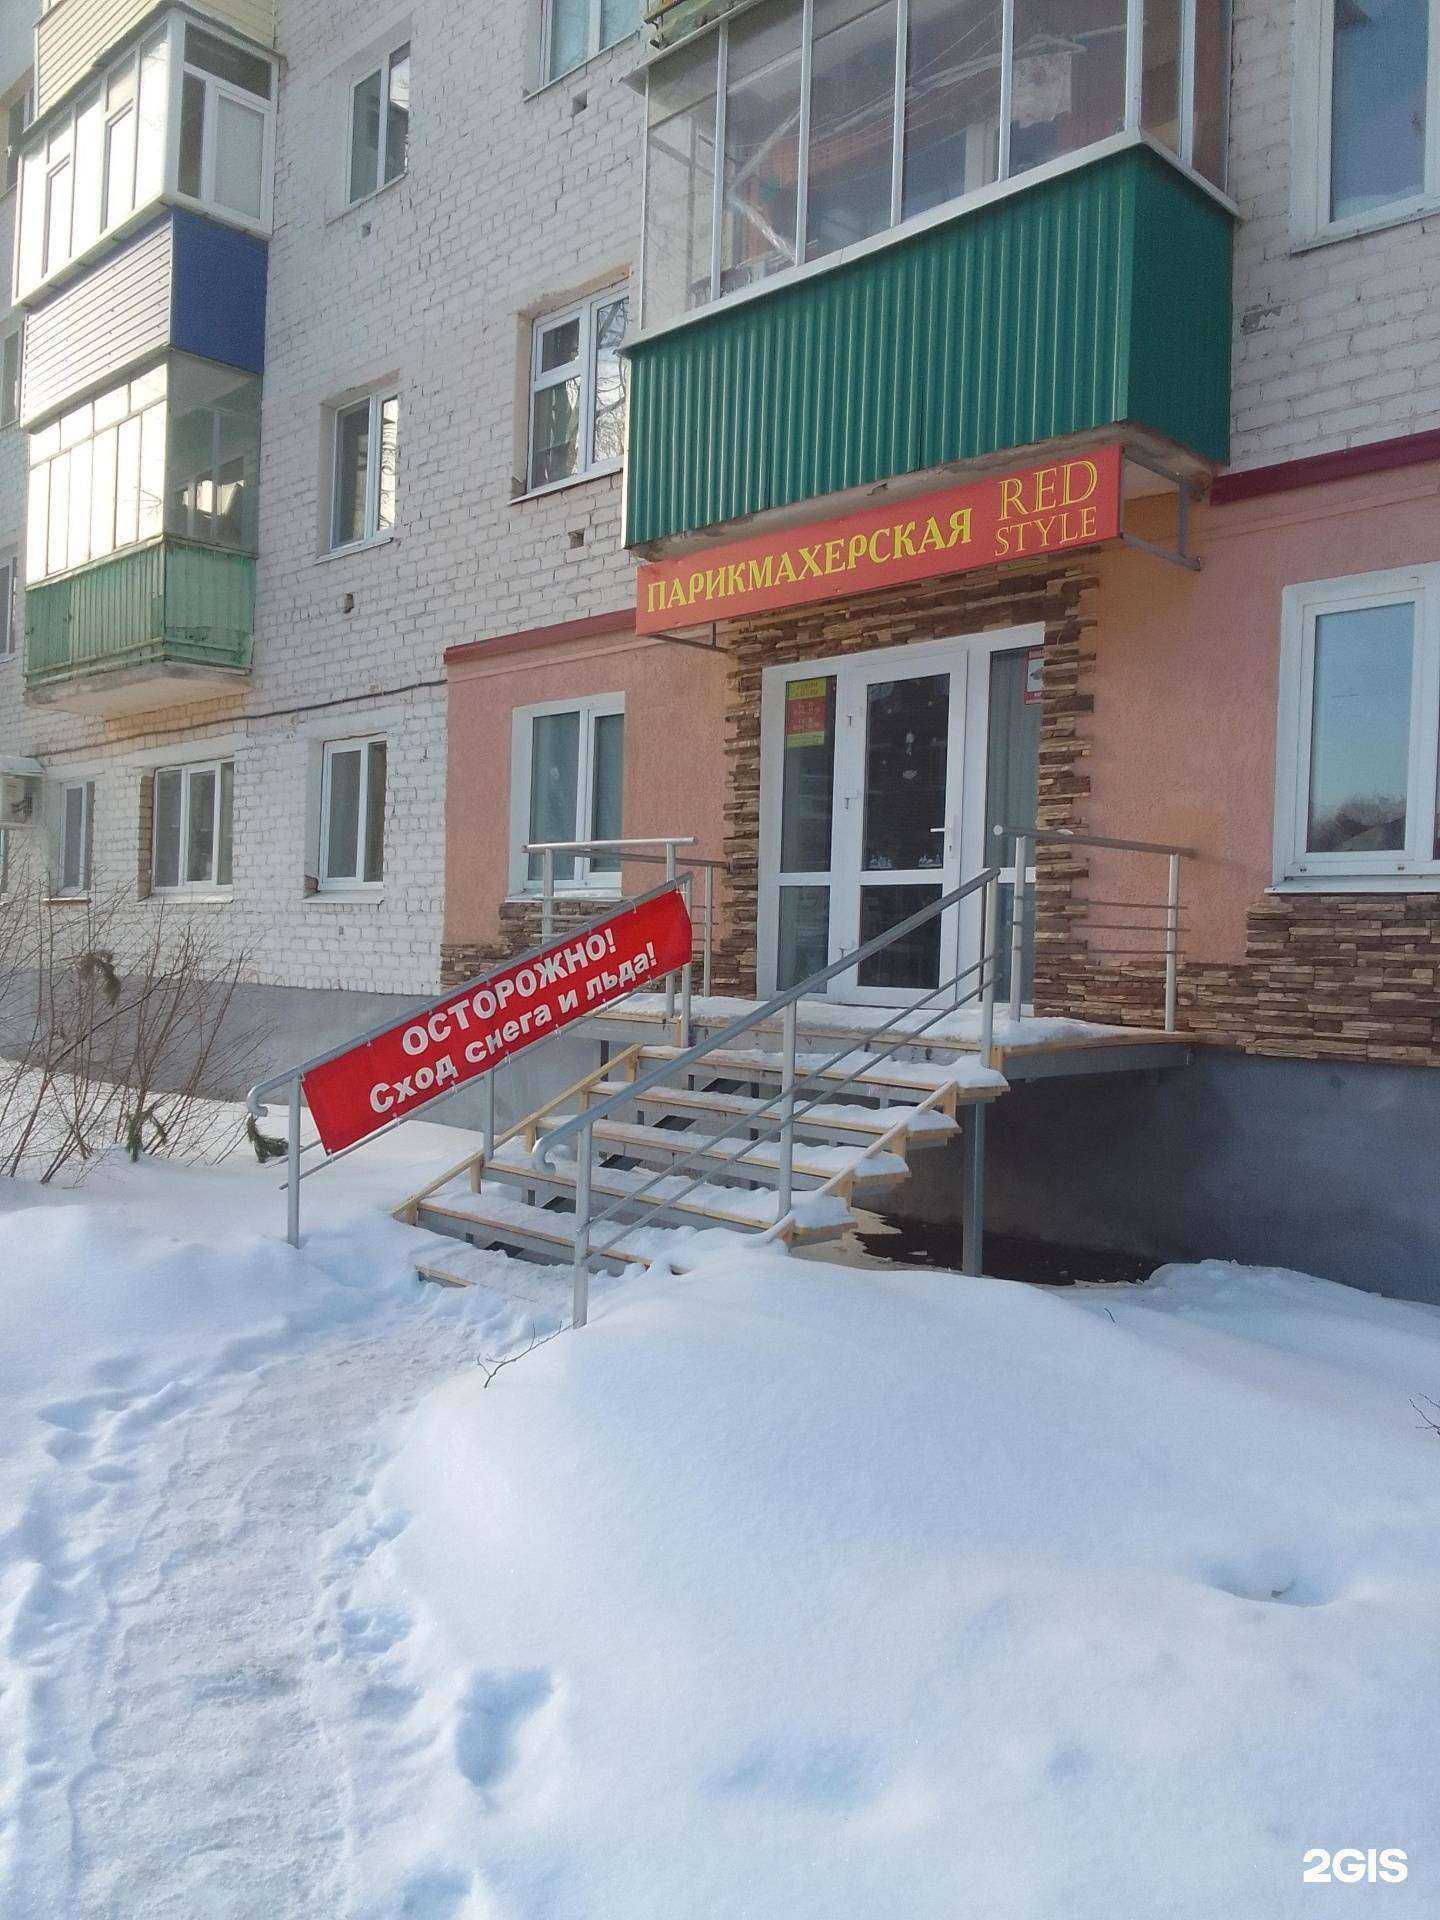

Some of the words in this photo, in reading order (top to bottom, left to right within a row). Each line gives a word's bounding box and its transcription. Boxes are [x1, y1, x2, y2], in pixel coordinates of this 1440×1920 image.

[994, 506, 1098, 557] STYLE
[998, 459, 1099, 521] RED
[647, 507, 972, 613] ПАРИКМАХЕРСКАЯ
[369, 1054, 458, 1114] Сход
[465, 1003, 552, 1063] снега
[558, 988, 579, 1013] и
[586, 941, 658, 1000] льда!
[402, 928, 616, 1056] ОСТОРОЖНО!
